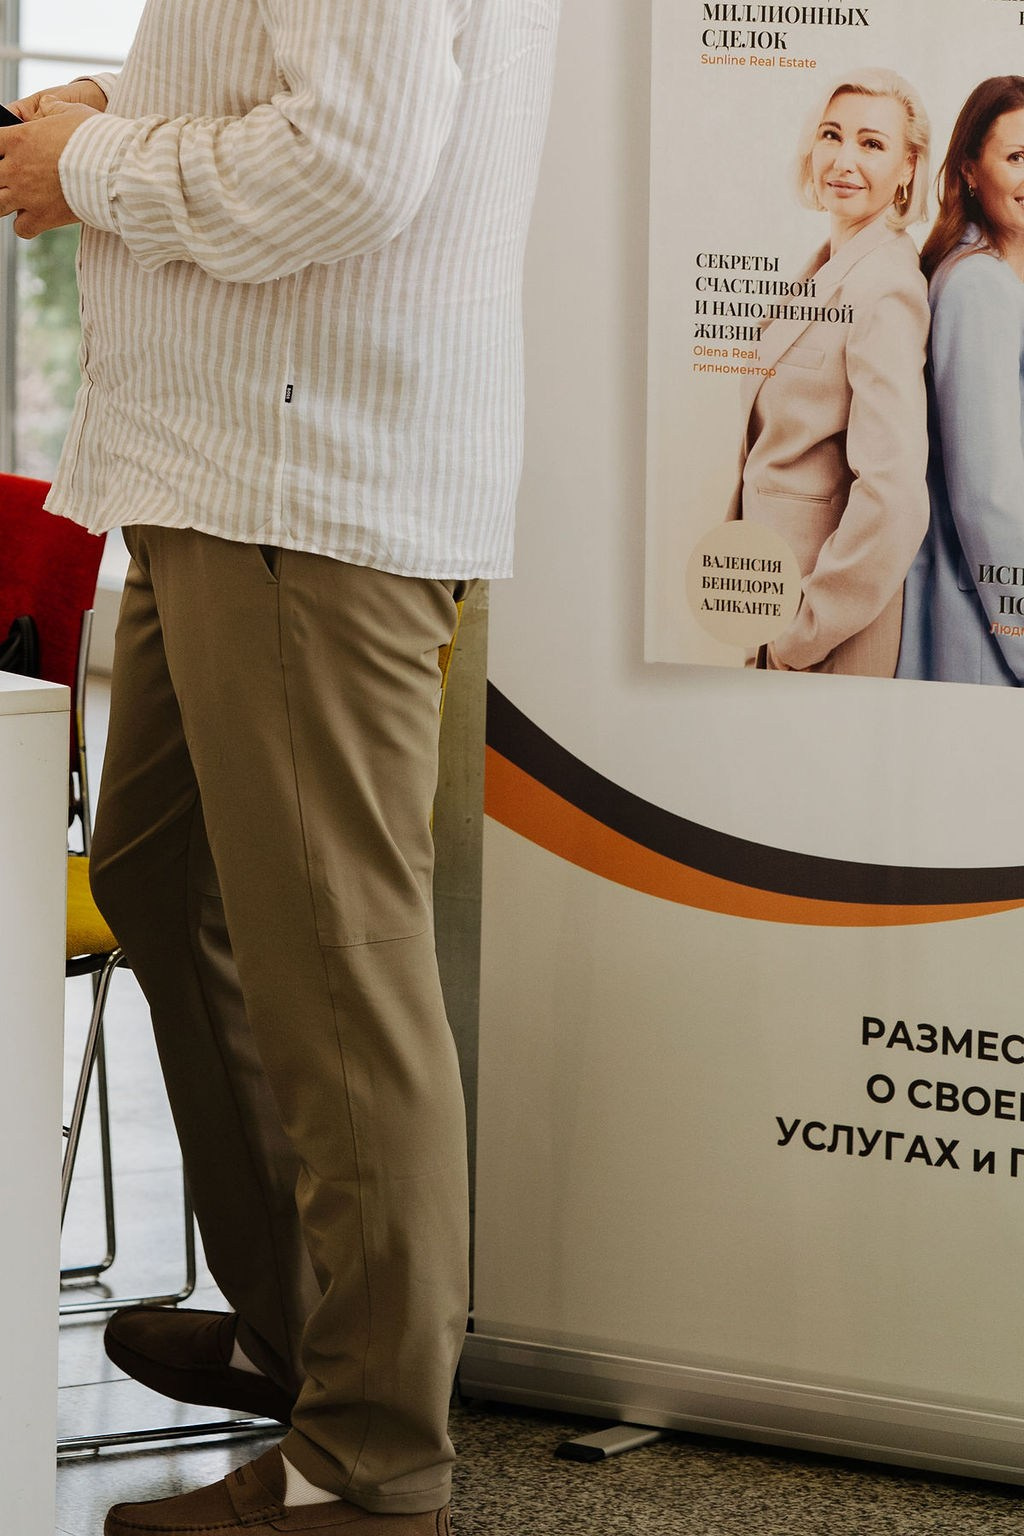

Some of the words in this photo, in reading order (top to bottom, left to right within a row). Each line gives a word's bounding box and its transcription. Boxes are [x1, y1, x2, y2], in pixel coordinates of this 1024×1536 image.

[702, 4, 870, 27] МИЛЛИОННЫХ
[701, 29, 788, 51] СДЕЛОК
[700, 53, 746, 66] Sunline
[749, 55, 775, 67] Real
[779, 56, 817, 69] Estate
[695, 252, 780, 272] СЕКРЕТЫ
[695, 276, 817, 299] СЧАСТЛИВОЙ
[694, 299, 710, 315] И
[712, 300, 854, 325] НАПОЛНЕННОЙ
[693, 322, 762, 342] ЖИЗНИ
[693, 345, 729, 359] Olena
[732, 348, 761, 361] Real,
[692, 363, 777, 379] гипноментор
[702, 554, 783, 574] ВАЛЕНСИЯ
[701, 576, 785, 596] БЕНИДОРМ
[700, 598, 782, 618] АЛИКАНТЕ
[990, 621, 1024, 637] Люд
[862, 1015, 1024, 1065] РАЗМЕС
[866, 1073, 896, 1105] О
[907, 1079, 1024, 1122] СВОЕ
[775, 1116, 960, 1170] УСЛУГАХ
[973, 1149, 996, 1175] и
